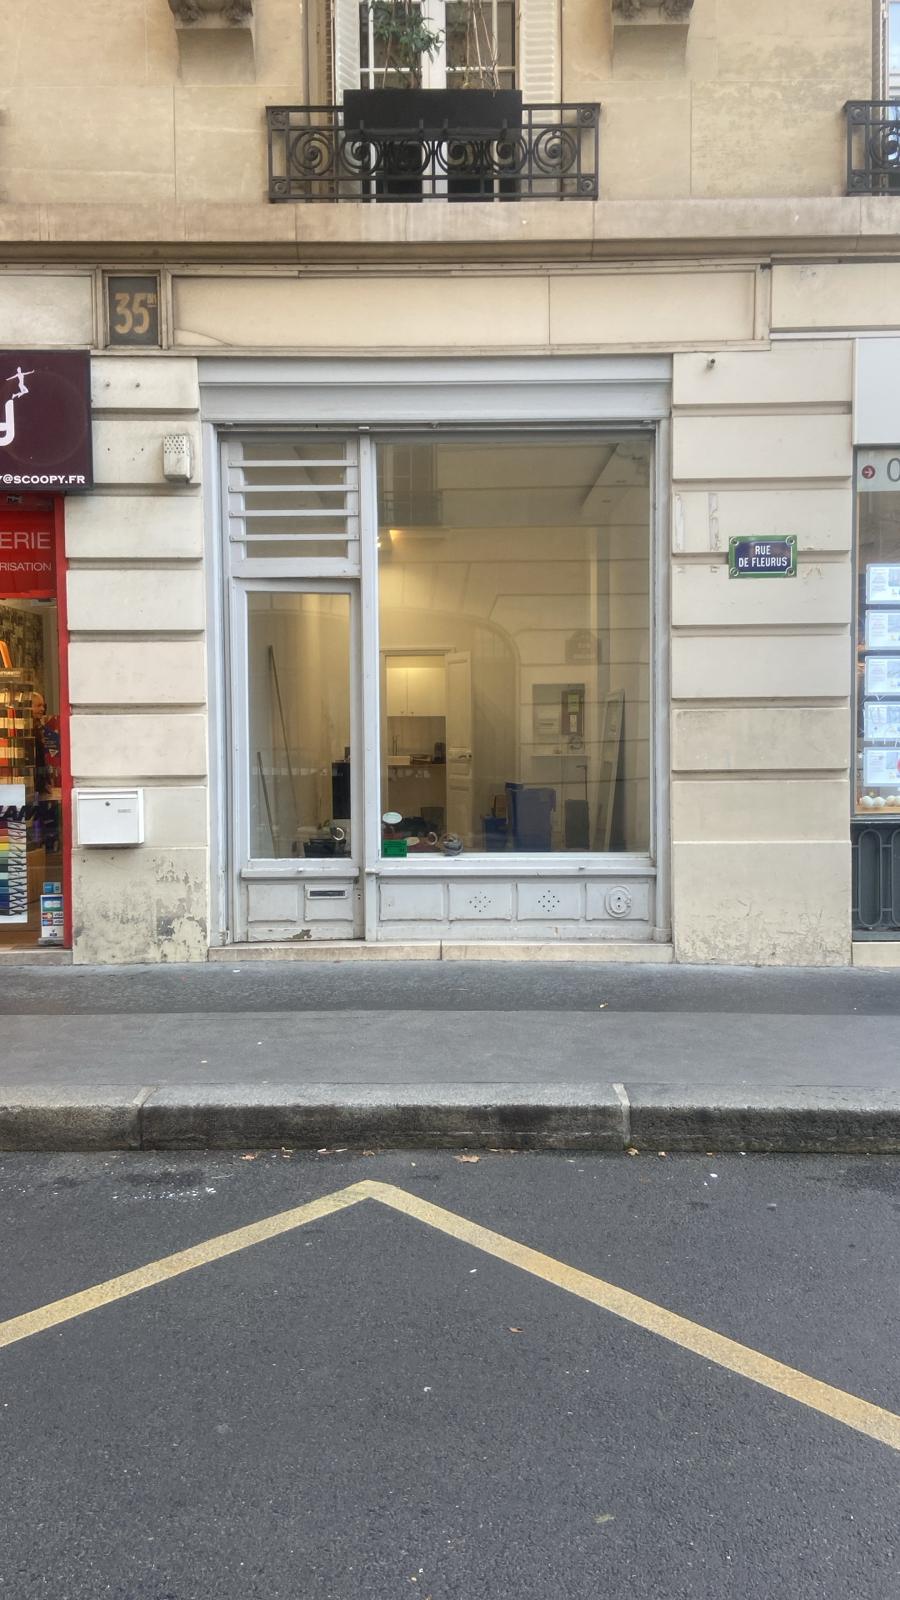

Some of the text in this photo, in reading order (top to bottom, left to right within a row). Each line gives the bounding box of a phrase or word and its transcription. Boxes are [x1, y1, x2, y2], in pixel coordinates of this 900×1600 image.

[0, 473, 86, 484] @SCOOPY.FR
[0, 531, 51, 549] ERIE
[755, 545, 771, 555] RUE
[0, 561, 52, 571] RISATION
[738, 556, 787, 567] DE FLEURUS
